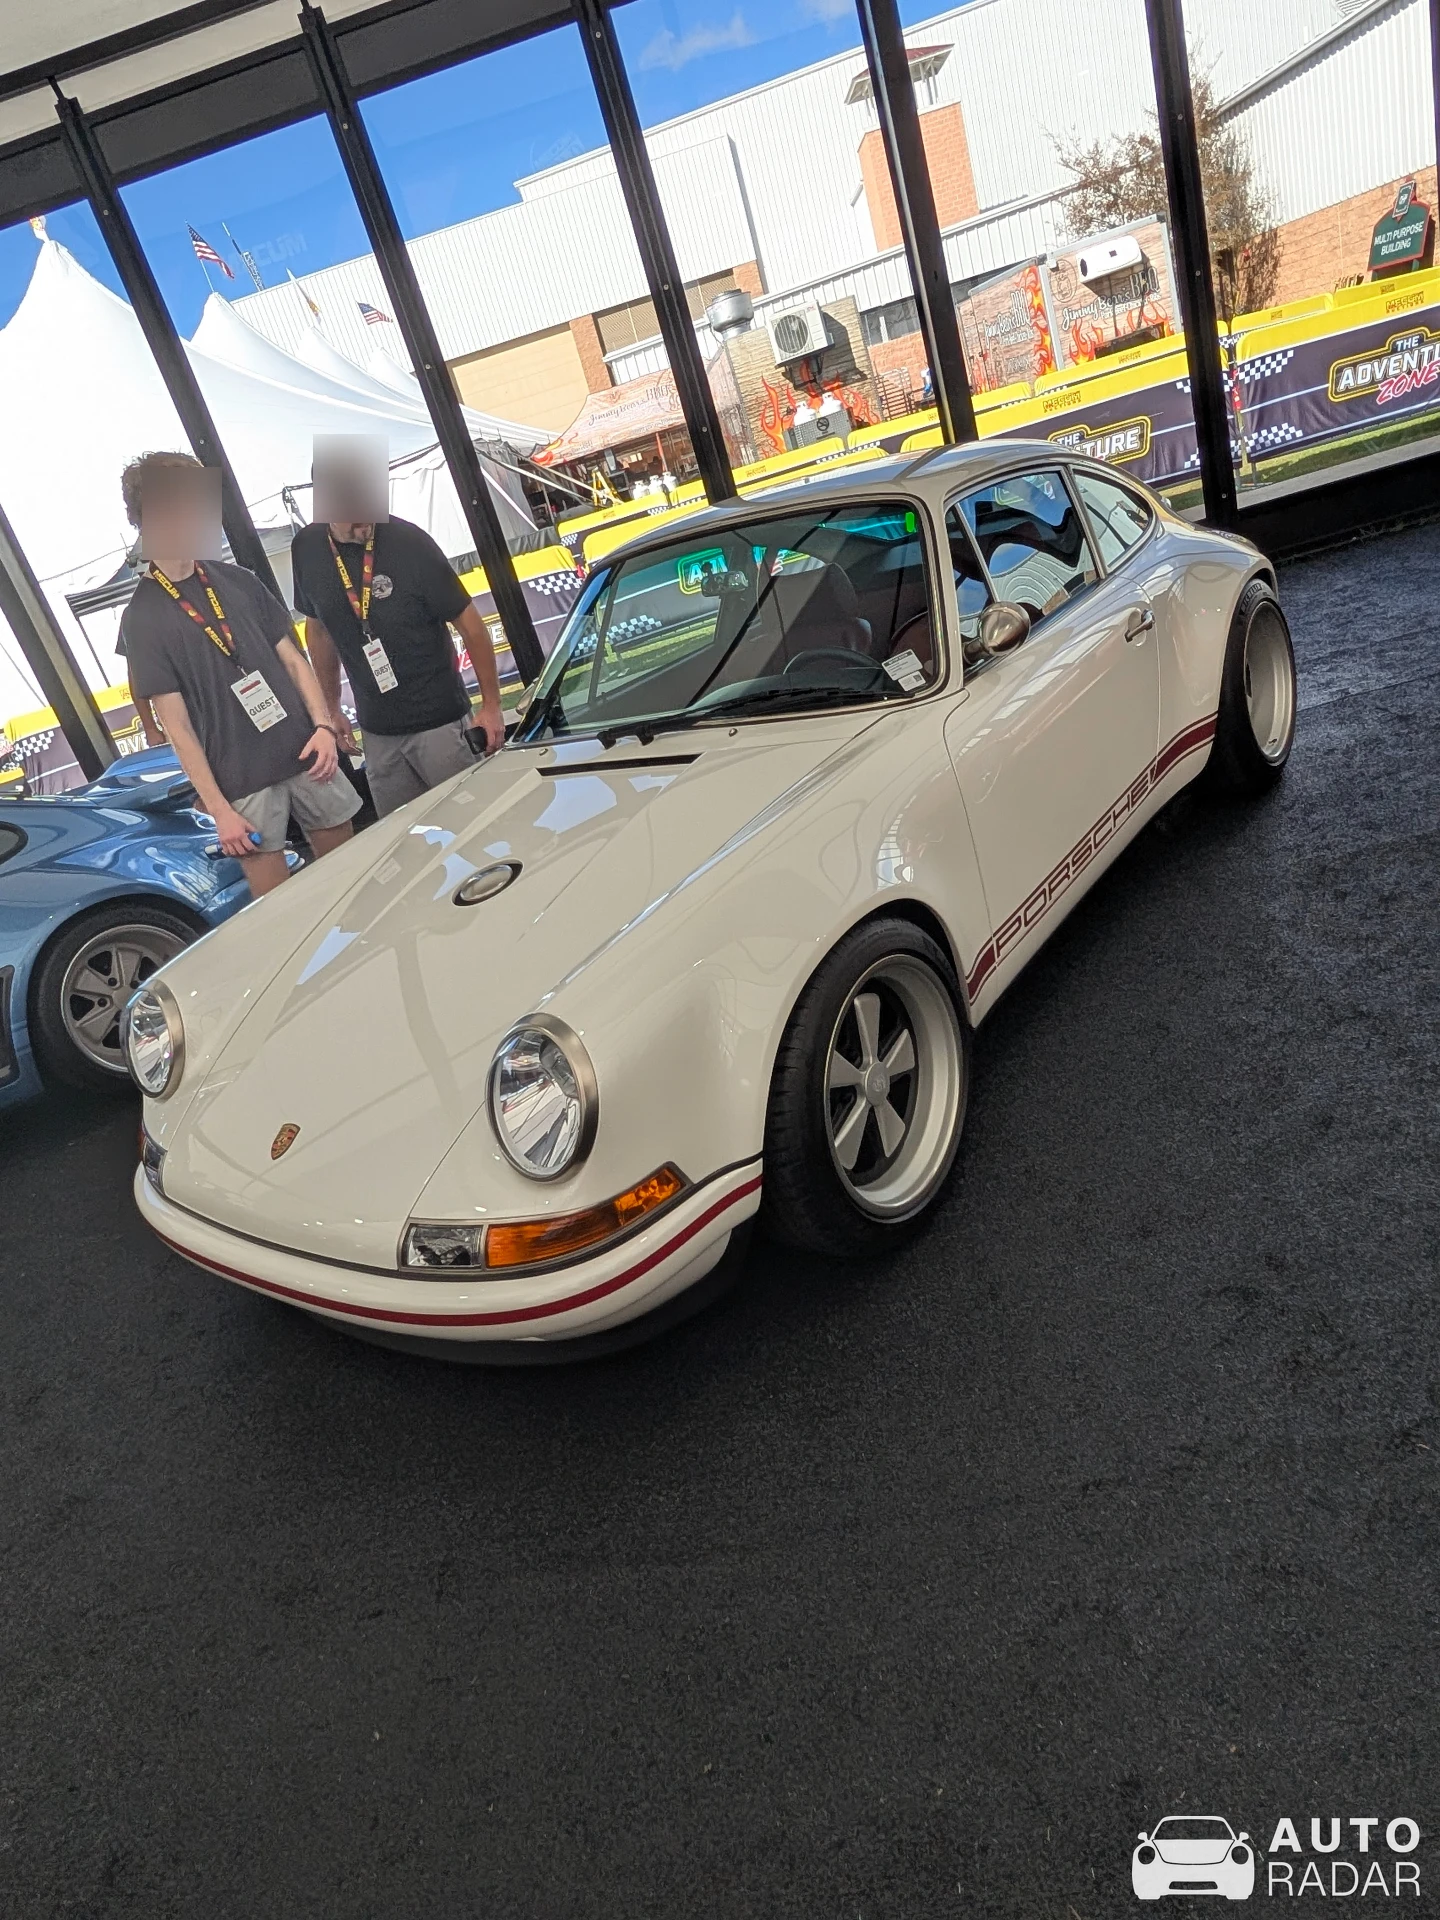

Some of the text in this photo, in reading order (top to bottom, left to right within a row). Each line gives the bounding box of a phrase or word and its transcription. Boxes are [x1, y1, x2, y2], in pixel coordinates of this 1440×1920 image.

[1374, 221, 1425, 246] MULTI PURPOSE
[1381, 237, 1411, 255] BUILDING
[1062, 303, 1098, 331] Jimmy
[1129, 266, 1161, 298] BBQ
[1396, 335, 1420, 352] THE
[1377, 361, 1440, 404] ZONE
[1057, 433, 1080, 447] THE
[153, 570, 180, 599] MECUM
[205, 626, 231, 657] MECUM
[374, 663, 391, 677] GUEST
[249, 696, 276, 716] GUEST
[996, 773, 1149, 958] PORSCHE
